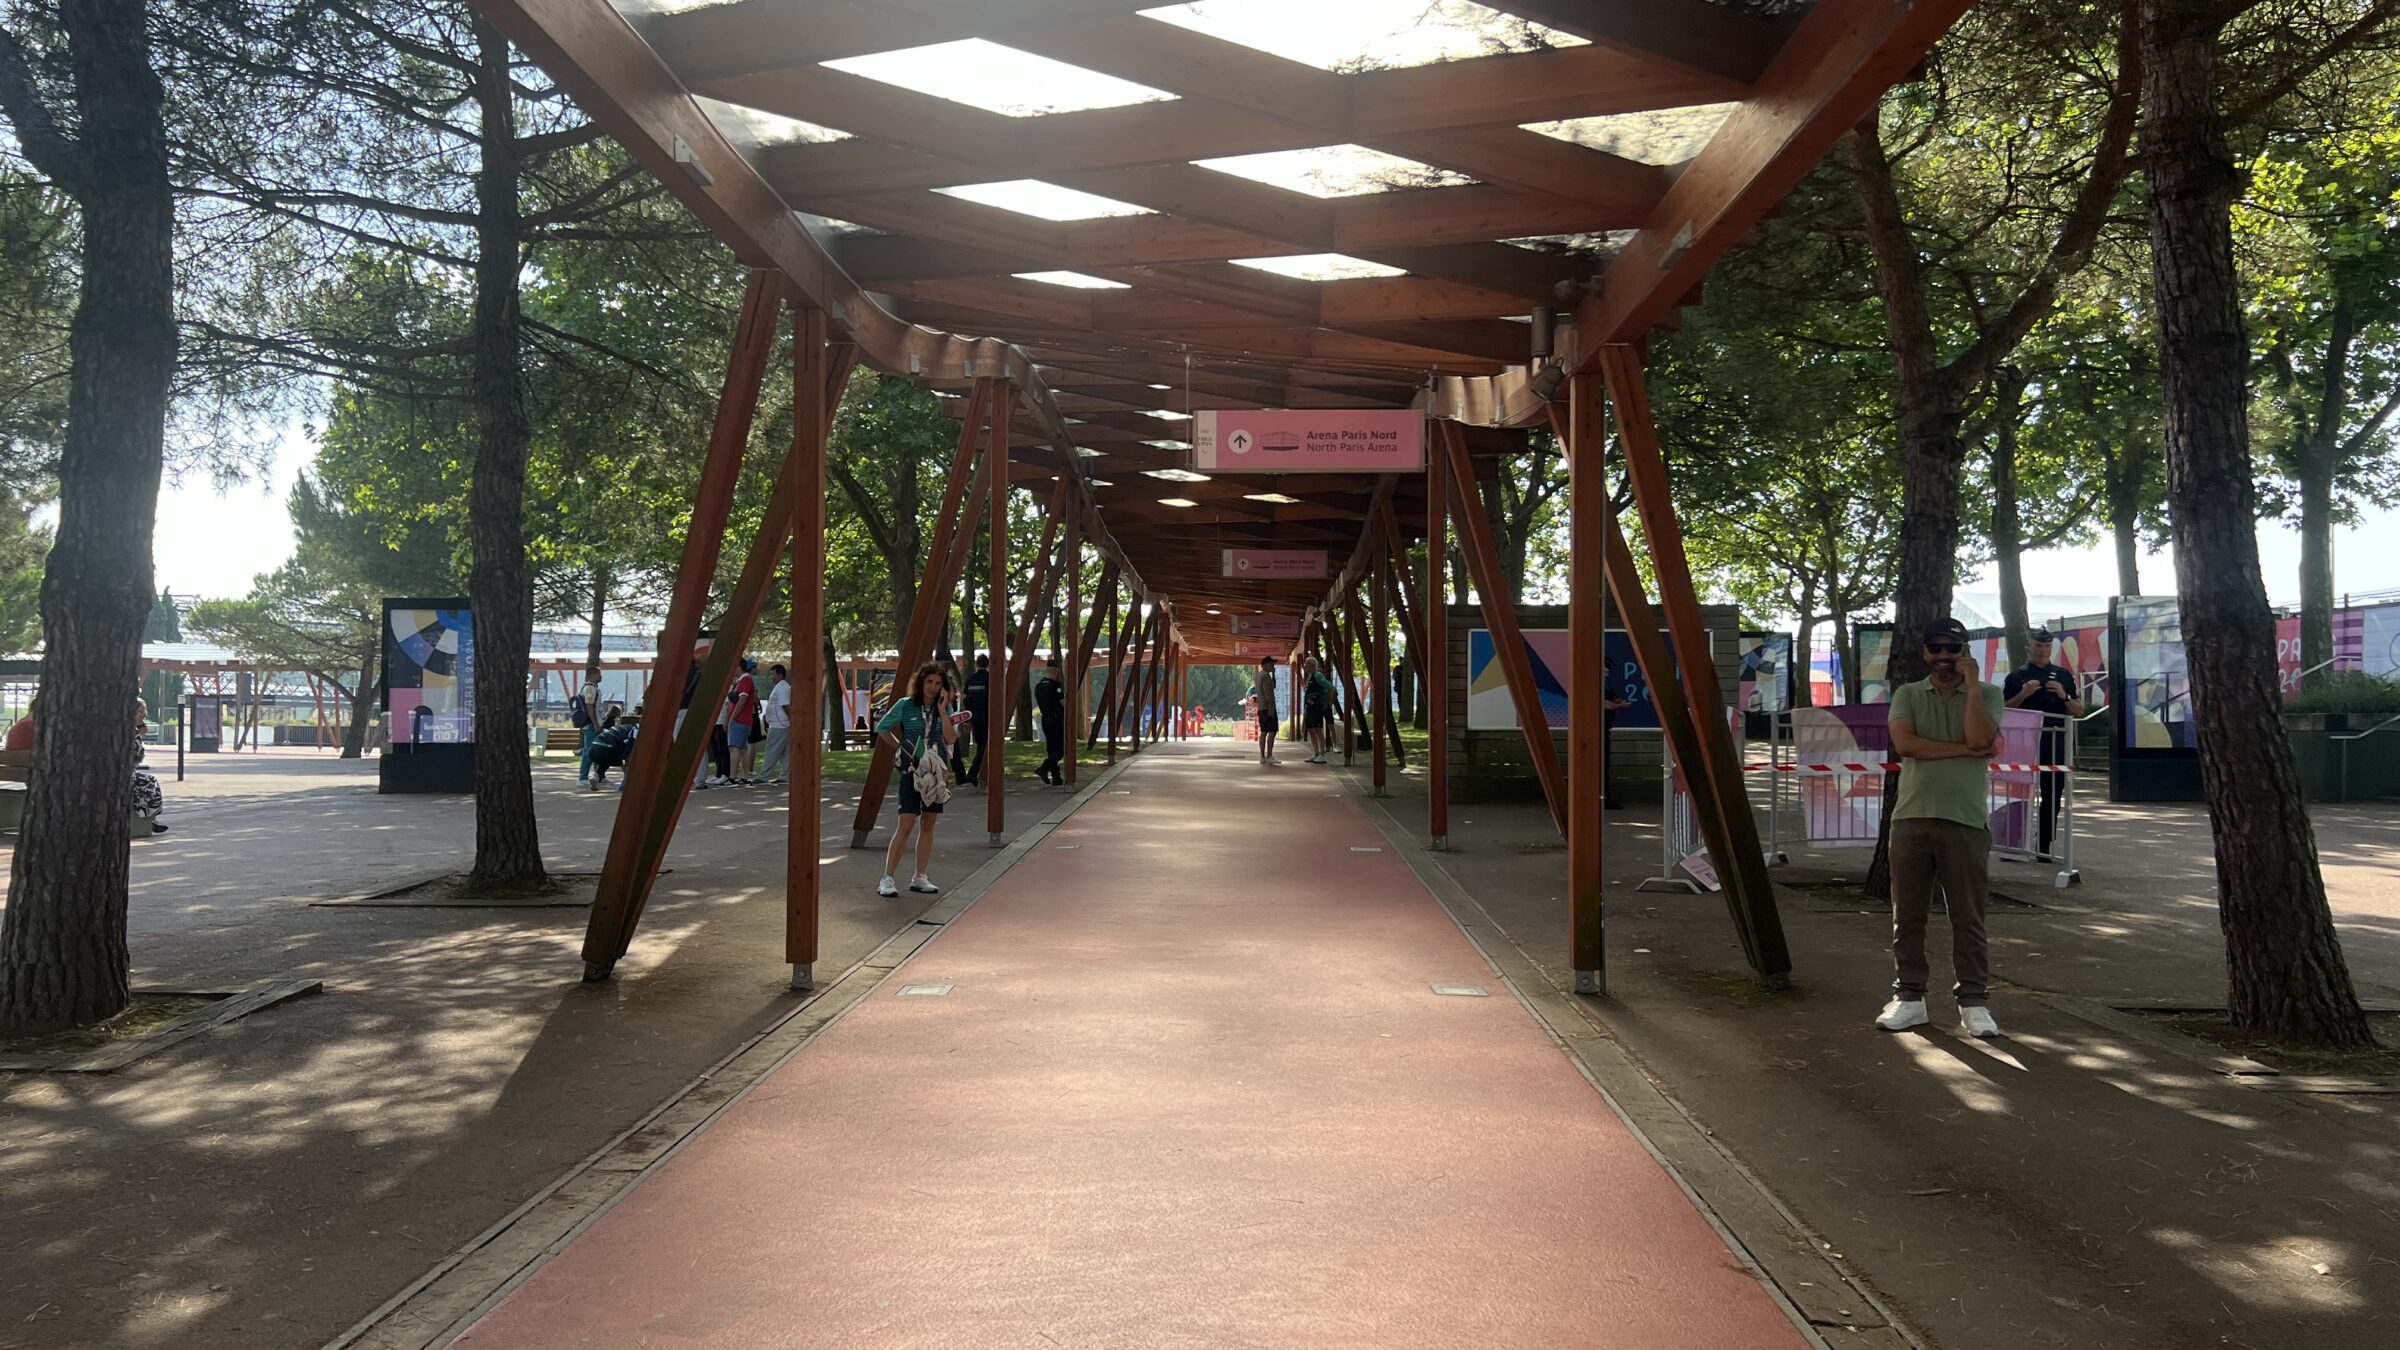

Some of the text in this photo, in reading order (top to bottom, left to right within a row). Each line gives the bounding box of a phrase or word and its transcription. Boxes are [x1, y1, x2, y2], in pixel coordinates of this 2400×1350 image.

[1307, 429, 1397, 440] Arena Paris Nord
[1306, 442, 1398, 452] North Paris Arena
